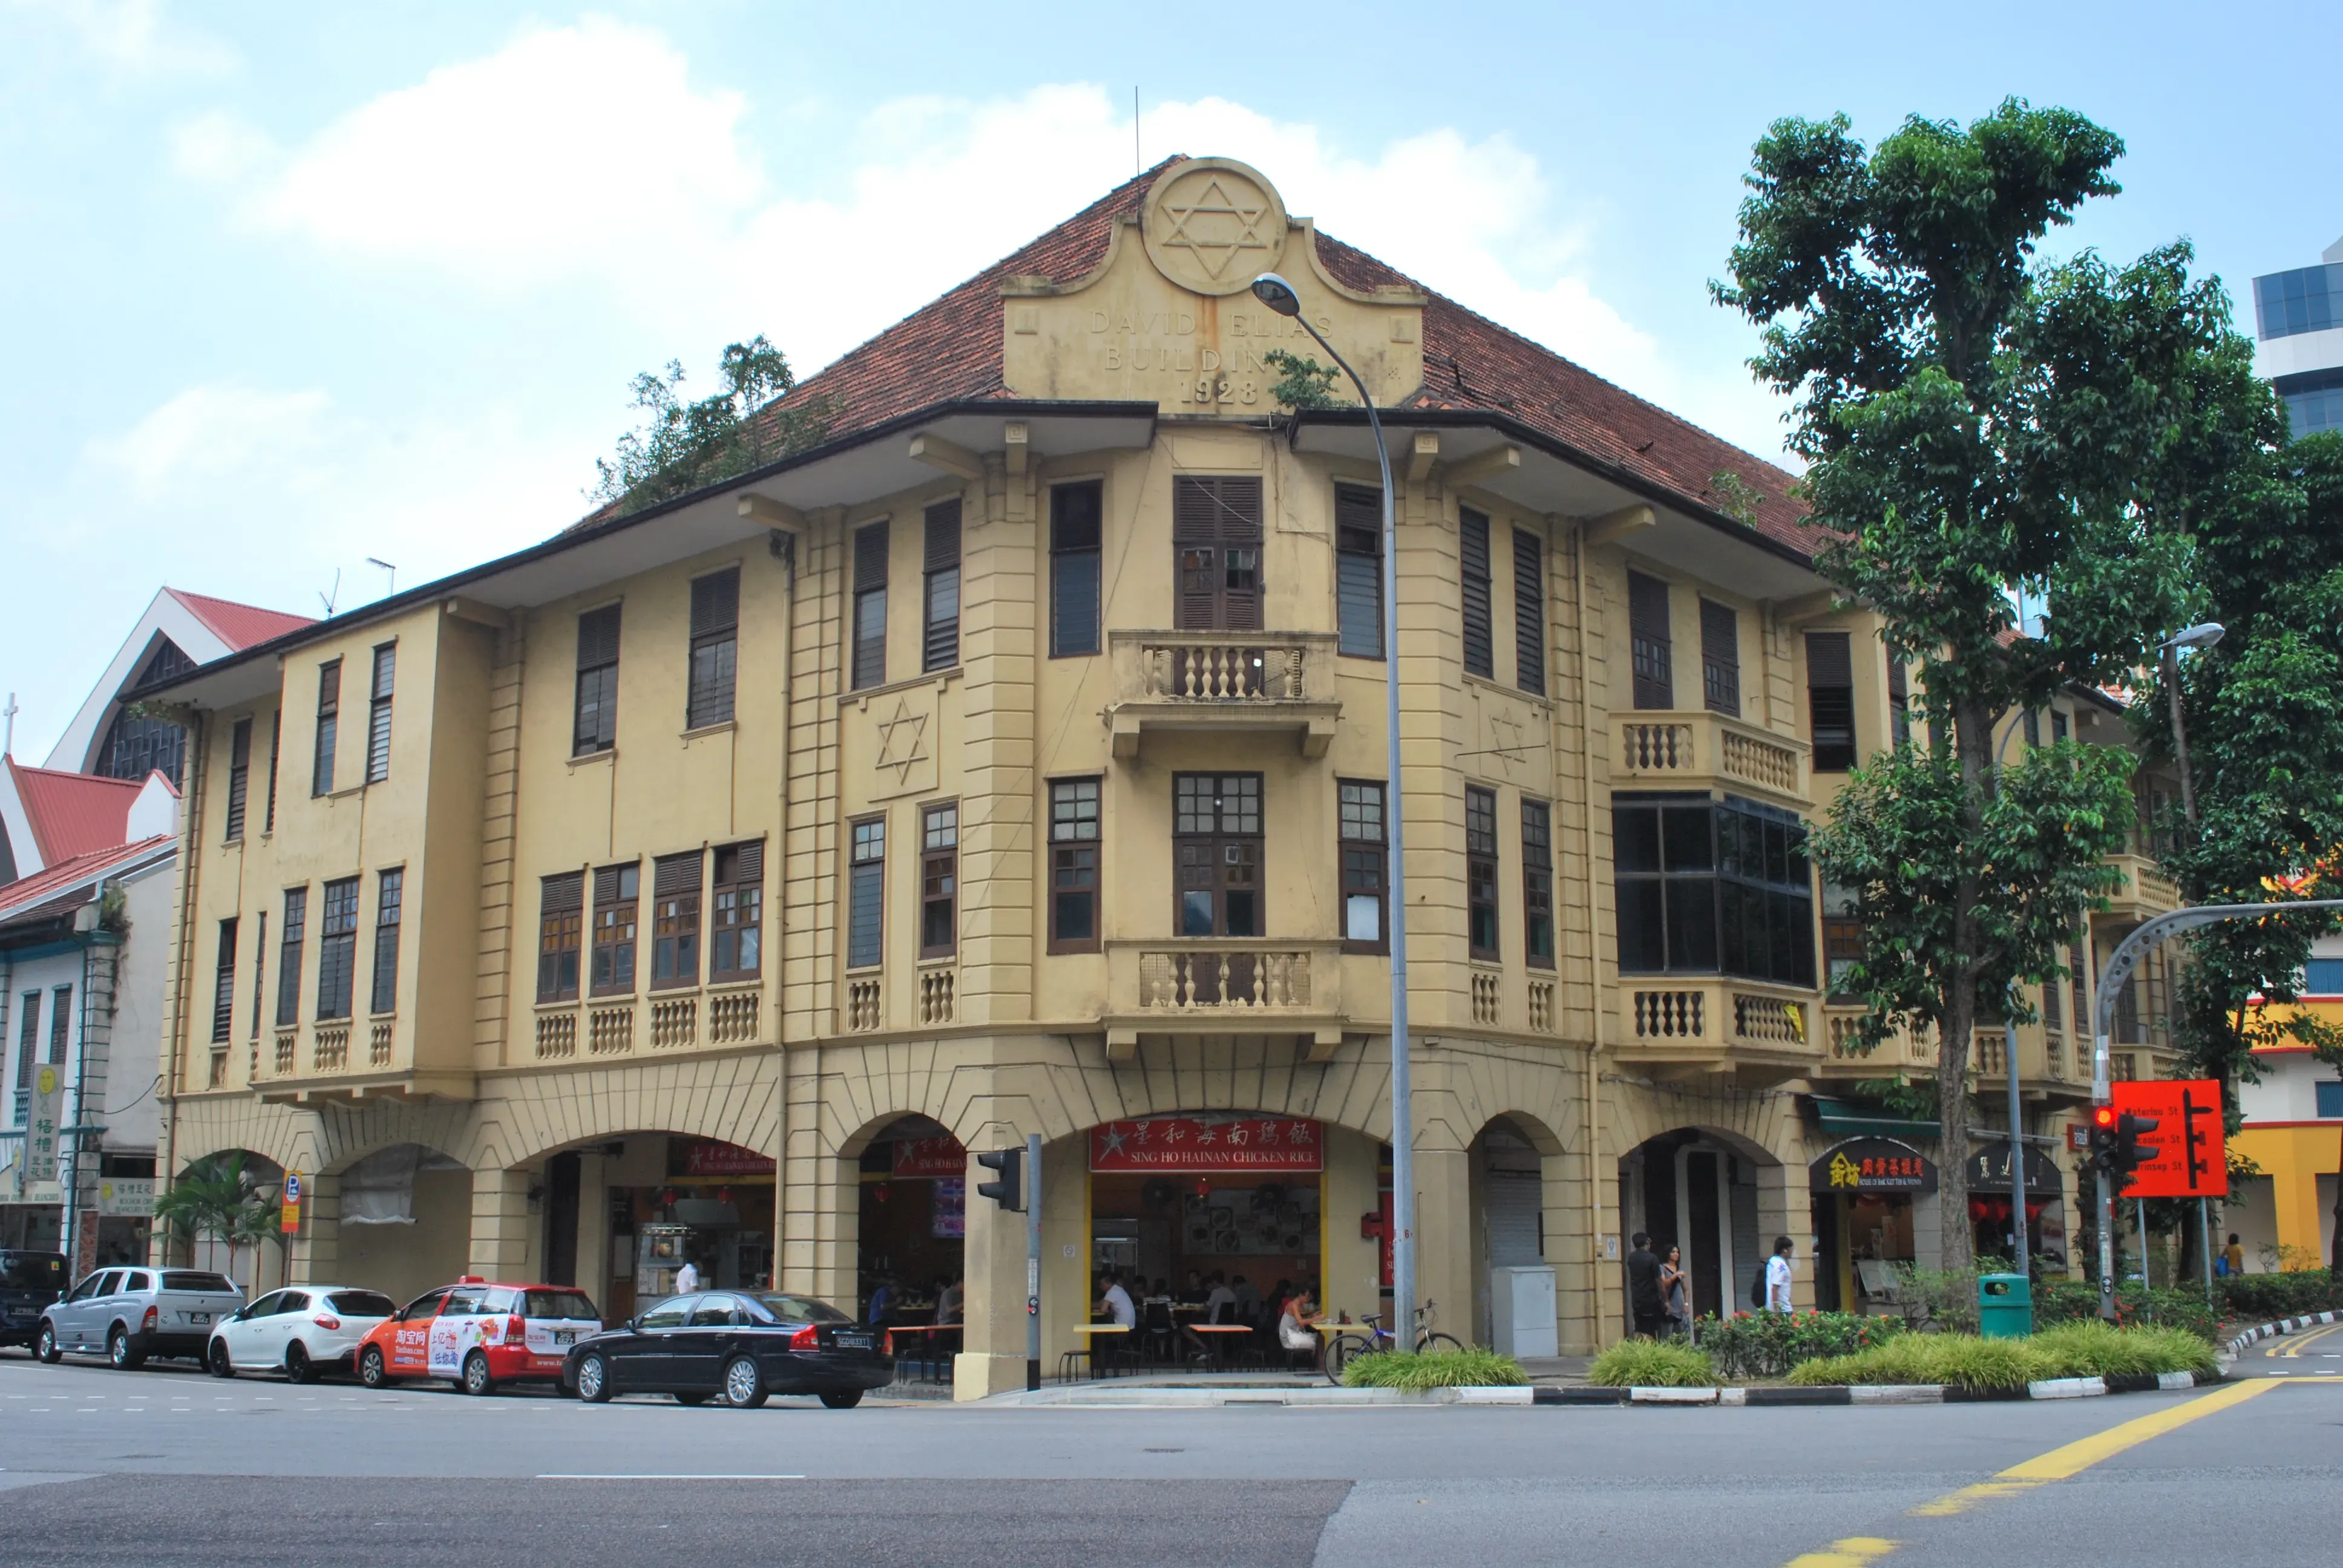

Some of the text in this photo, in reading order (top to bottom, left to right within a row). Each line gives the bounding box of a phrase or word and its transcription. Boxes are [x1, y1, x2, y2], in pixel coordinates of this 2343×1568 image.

[1090, 311, 1332, 338] DAVID ELIAS
[1104, 347, 1319, 373] BUILDIN
[1181, 379, 1257, 405] 1928
[2125, 1106, 2178, 1116] Waterloo St
[2137, 1134, 2181, 1144] coolen St
[1131, 1151, 1316, 1163] SING HO HAINAN CHICKEN RICE
[2172, 1161, 2183, 1171] St
[287, 1175, 299, 1195] P
[395, 1329, 426, 1346] 淘宝网
[395, 1345, 425, 1355] Taobao.com
